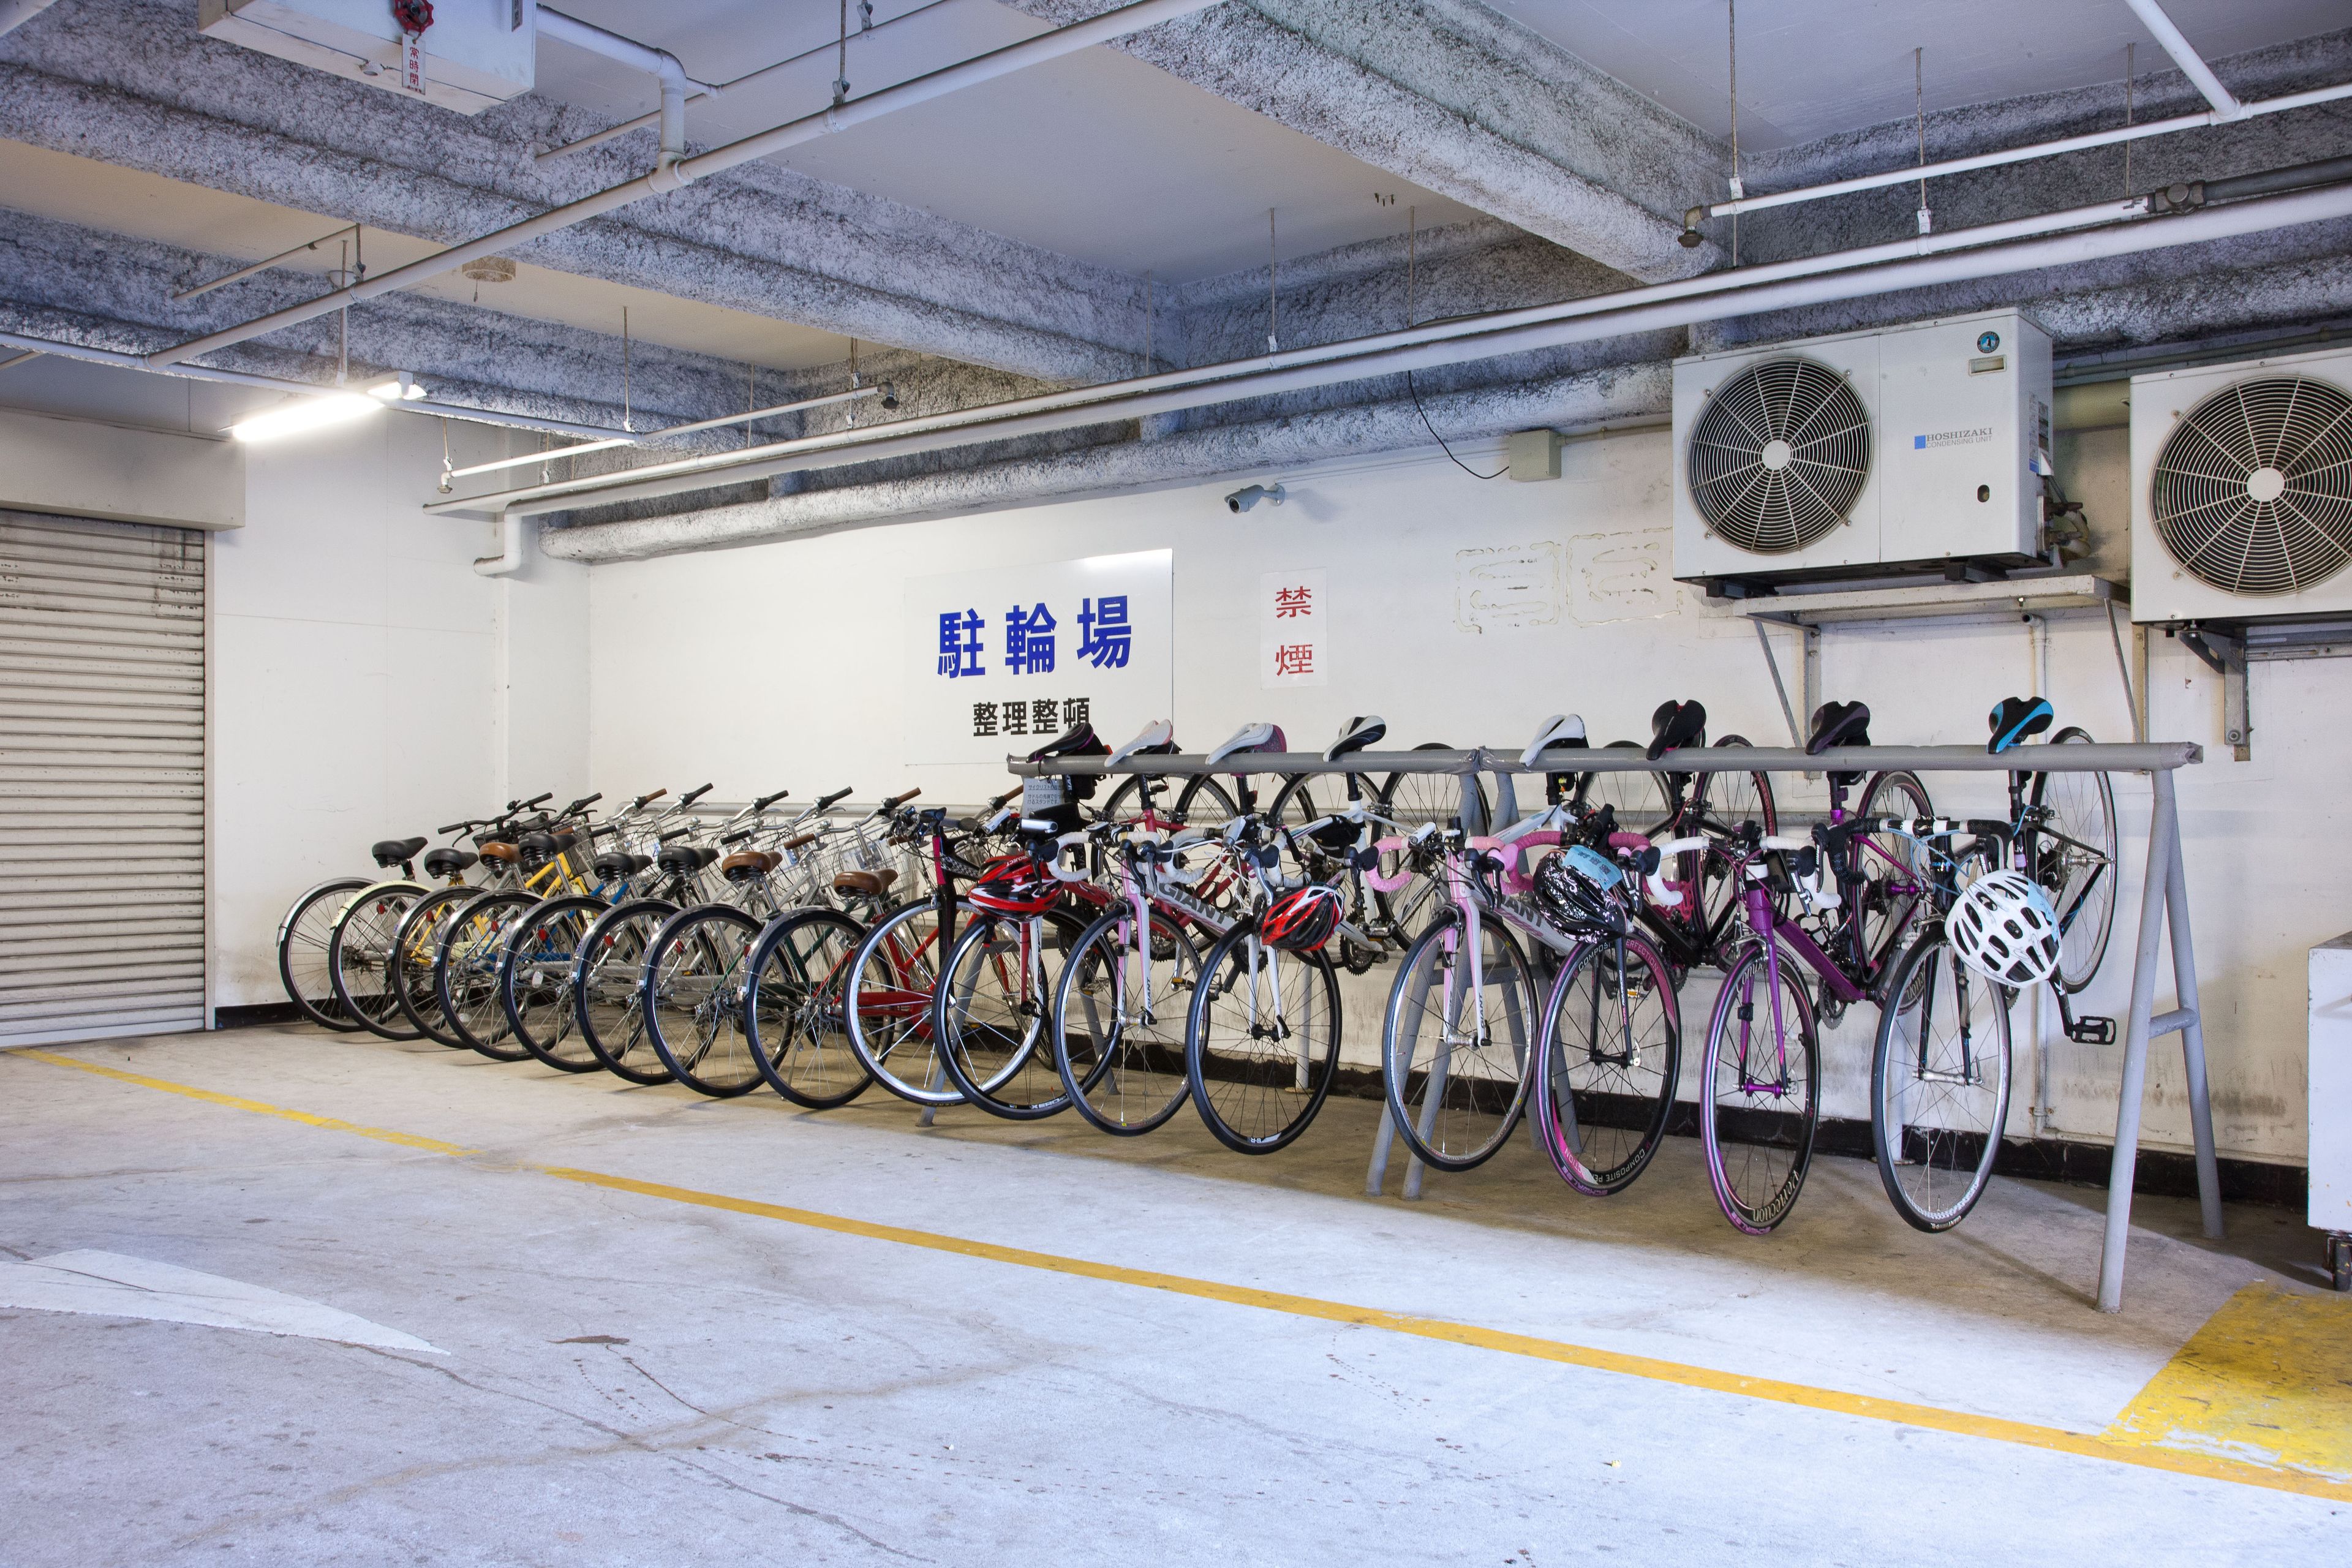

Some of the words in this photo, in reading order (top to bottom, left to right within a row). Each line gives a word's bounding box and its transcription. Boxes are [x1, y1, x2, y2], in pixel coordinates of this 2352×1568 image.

[409, 46, 420, 86] 常時閉
[1926, 439, 1973, 448] CONDENSING
[1927, 428, 1992, 442] HOSHIZAKI
[938, 595, 1132, 679] 駐輪場
[1275, 586, 1314, 677] 禁煙
[973, 697, 1090, 737] 整理整頓
[1159, 883, 1227, 924] GIANT
[1578, 942, 1611, 972] COMPOSI
[1626, 939, 1659, 972] ERFECTION
[1605, 1148, 1646, 1182] COMPOSITE
